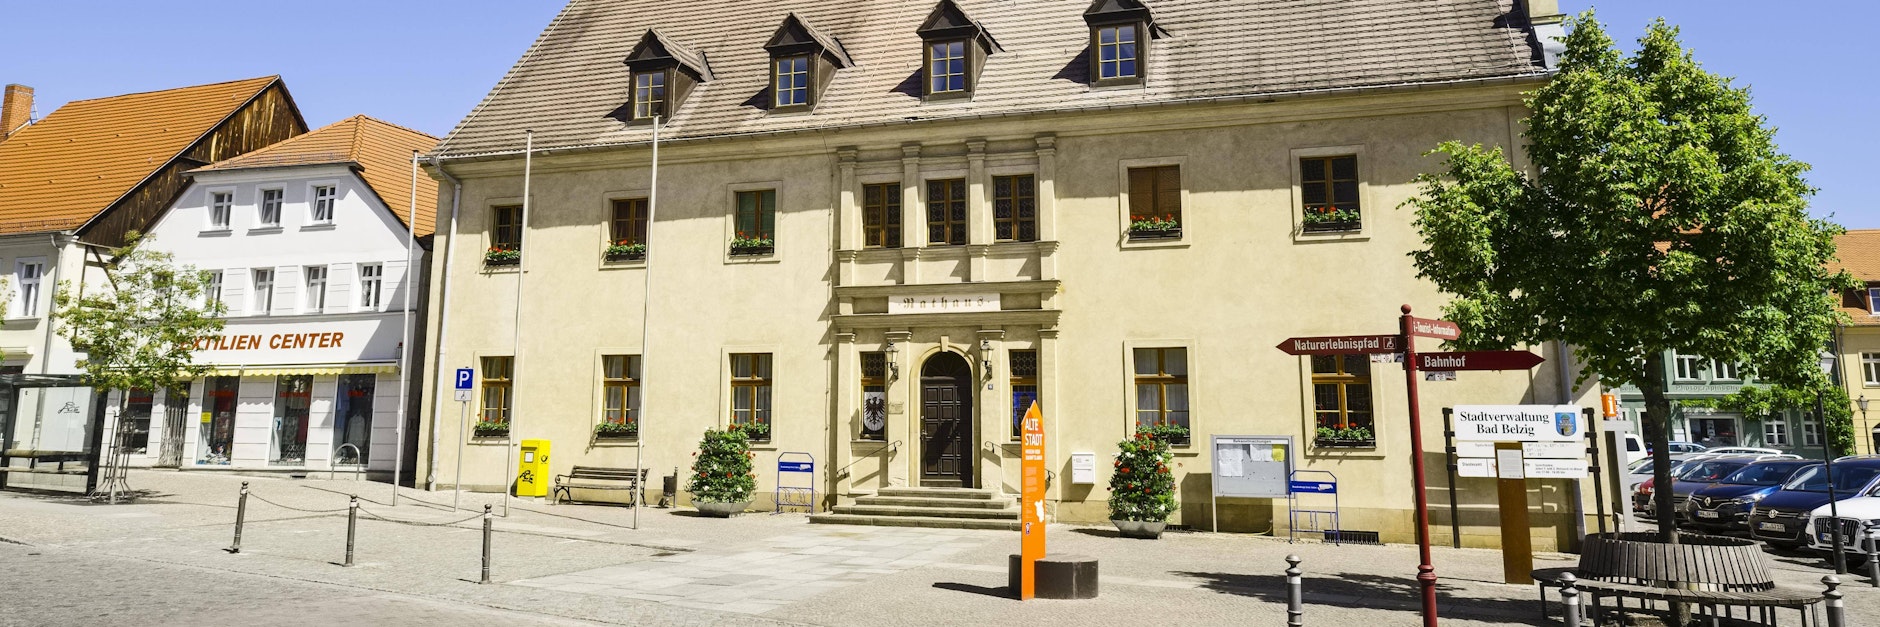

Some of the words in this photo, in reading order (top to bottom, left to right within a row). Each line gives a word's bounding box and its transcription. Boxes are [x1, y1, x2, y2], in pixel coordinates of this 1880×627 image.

[903, 296, 984, 310] Rathaus
[180, 334, 262, 351] EXTILIEN
[269, 332, 344, 350] CENTER
[1294, 338, 1379, 352] Naturerlebnispfad
[1424, 355, 1466, 368] Bahnhof
[459, 370, 470, 387] P
[1675, 384, 1741, 392] Photographische
[1460, 411, 1550, 424] Stadtverwaltung
[1025, 418, 1038, 431] ALTE
[1476, 424, 1498, 434] Bad
[1502, 423, 1535, 437] Belzig
[1025, 433, 1043, 446] STADT
